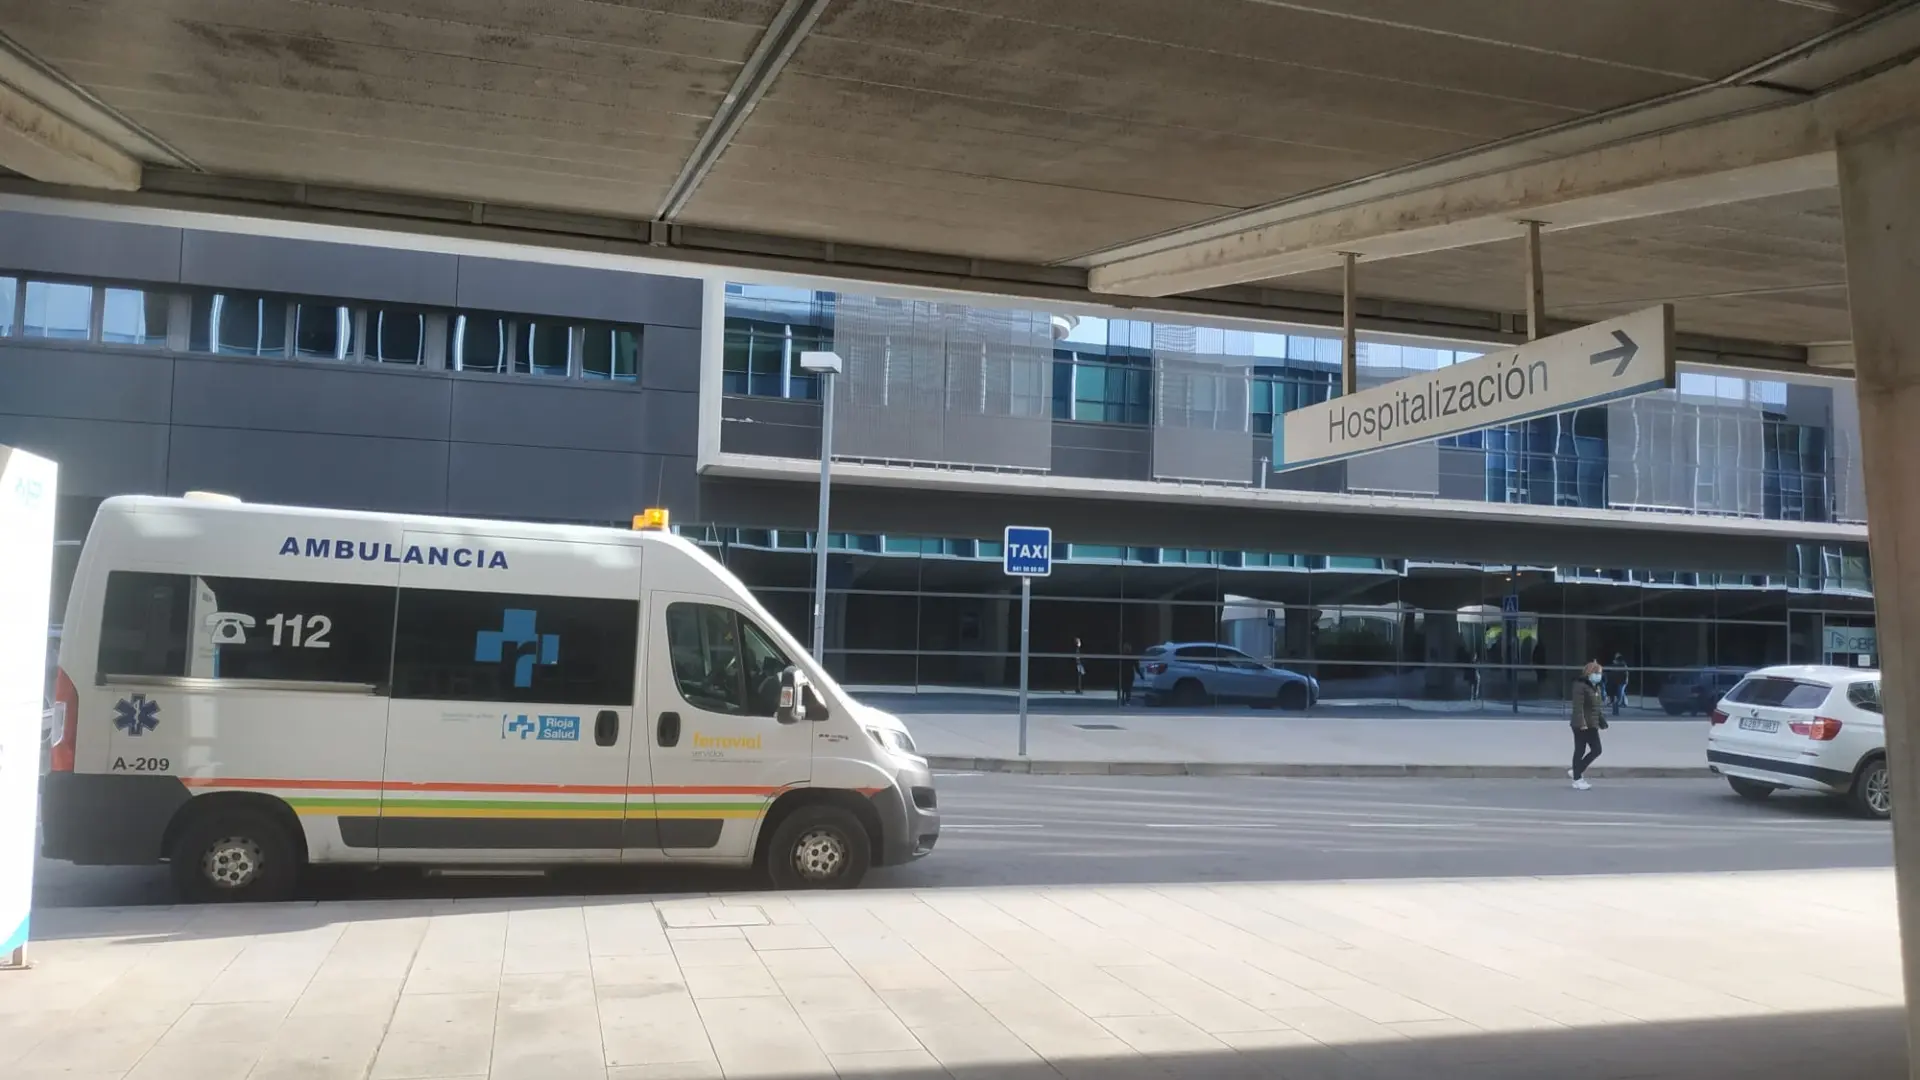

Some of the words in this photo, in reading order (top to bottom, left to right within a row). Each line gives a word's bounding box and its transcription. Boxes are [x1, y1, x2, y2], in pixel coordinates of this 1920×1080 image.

[1329, 354, 1548, 443] Hospitalización
[279, 536, 509, 570] AMBULANCIA
[1009, 544, 1048, 559] TAXI
[266, 613, 332, 649] 112
[546, 717, 574, 730] Rioja
[543, 728, 576, 740] Salud
[692, 731, 763, 750] ferrovial
[112, 756, 170, 771] A-209
